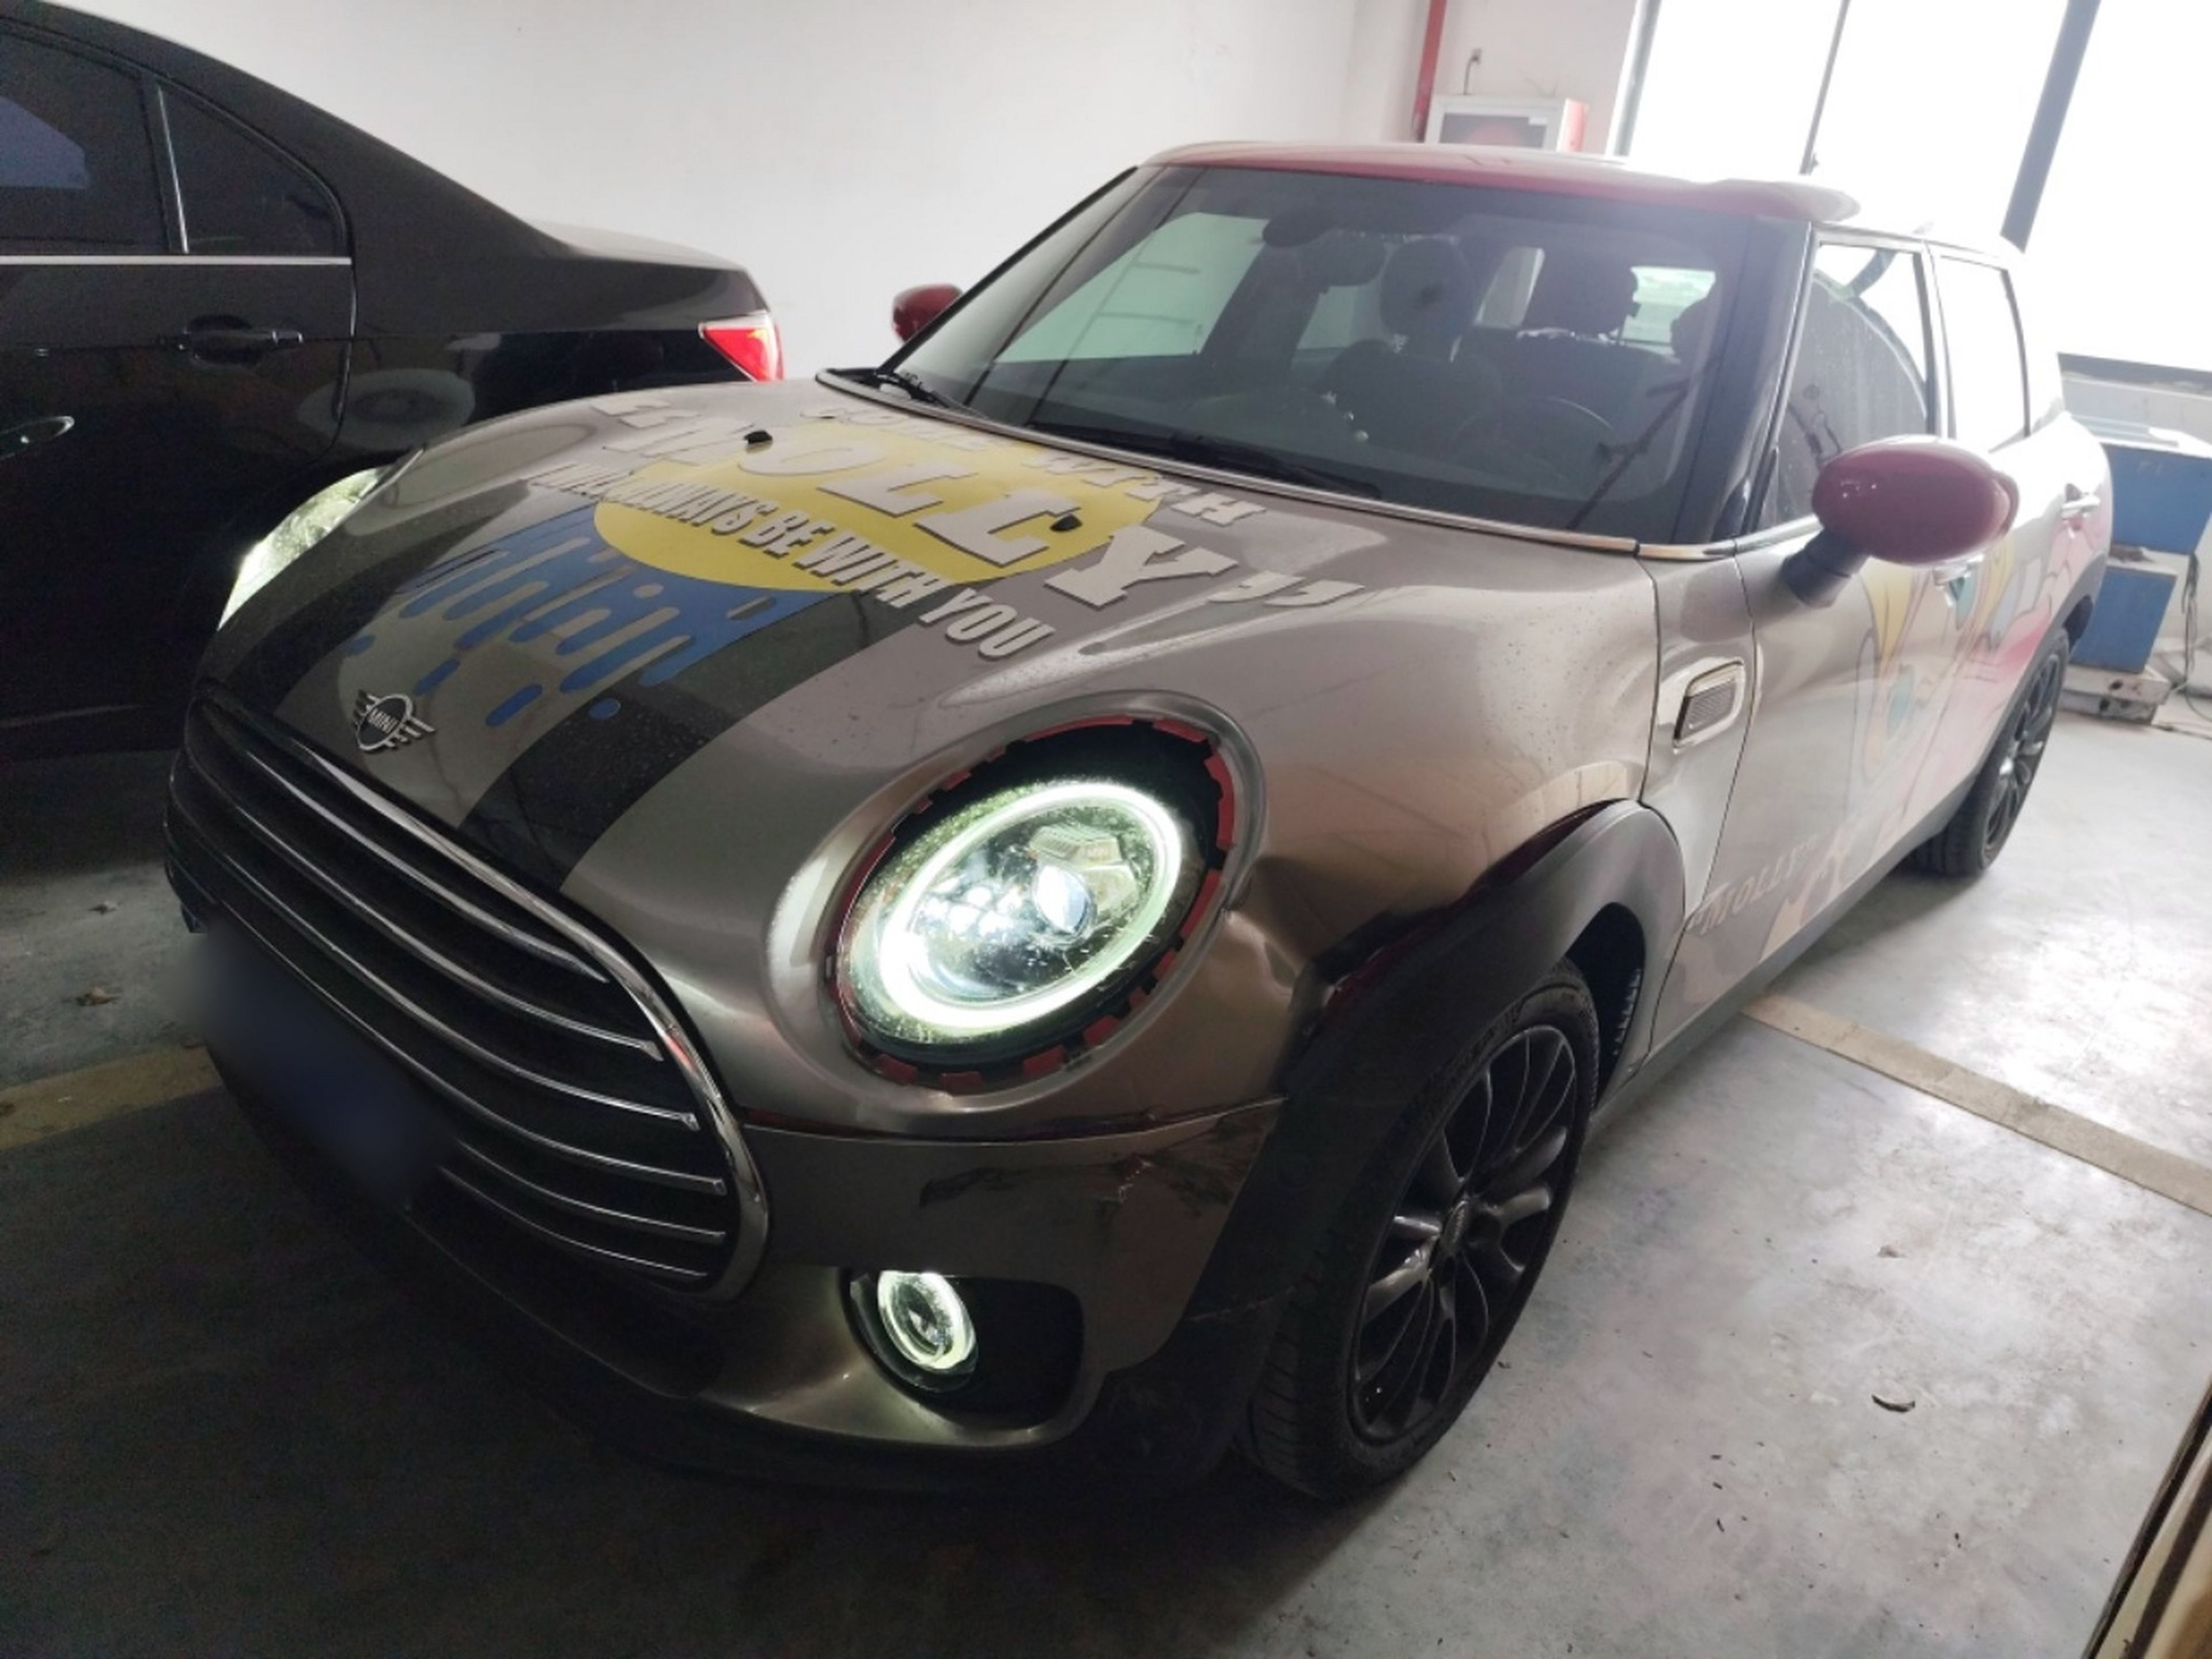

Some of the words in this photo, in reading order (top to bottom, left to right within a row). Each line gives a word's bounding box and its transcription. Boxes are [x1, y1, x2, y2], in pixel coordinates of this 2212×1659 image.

[738, 509, 834, 558] BE
[793, 529, 954, 609] WITH
[919, 588, 1056, 659] YOU
